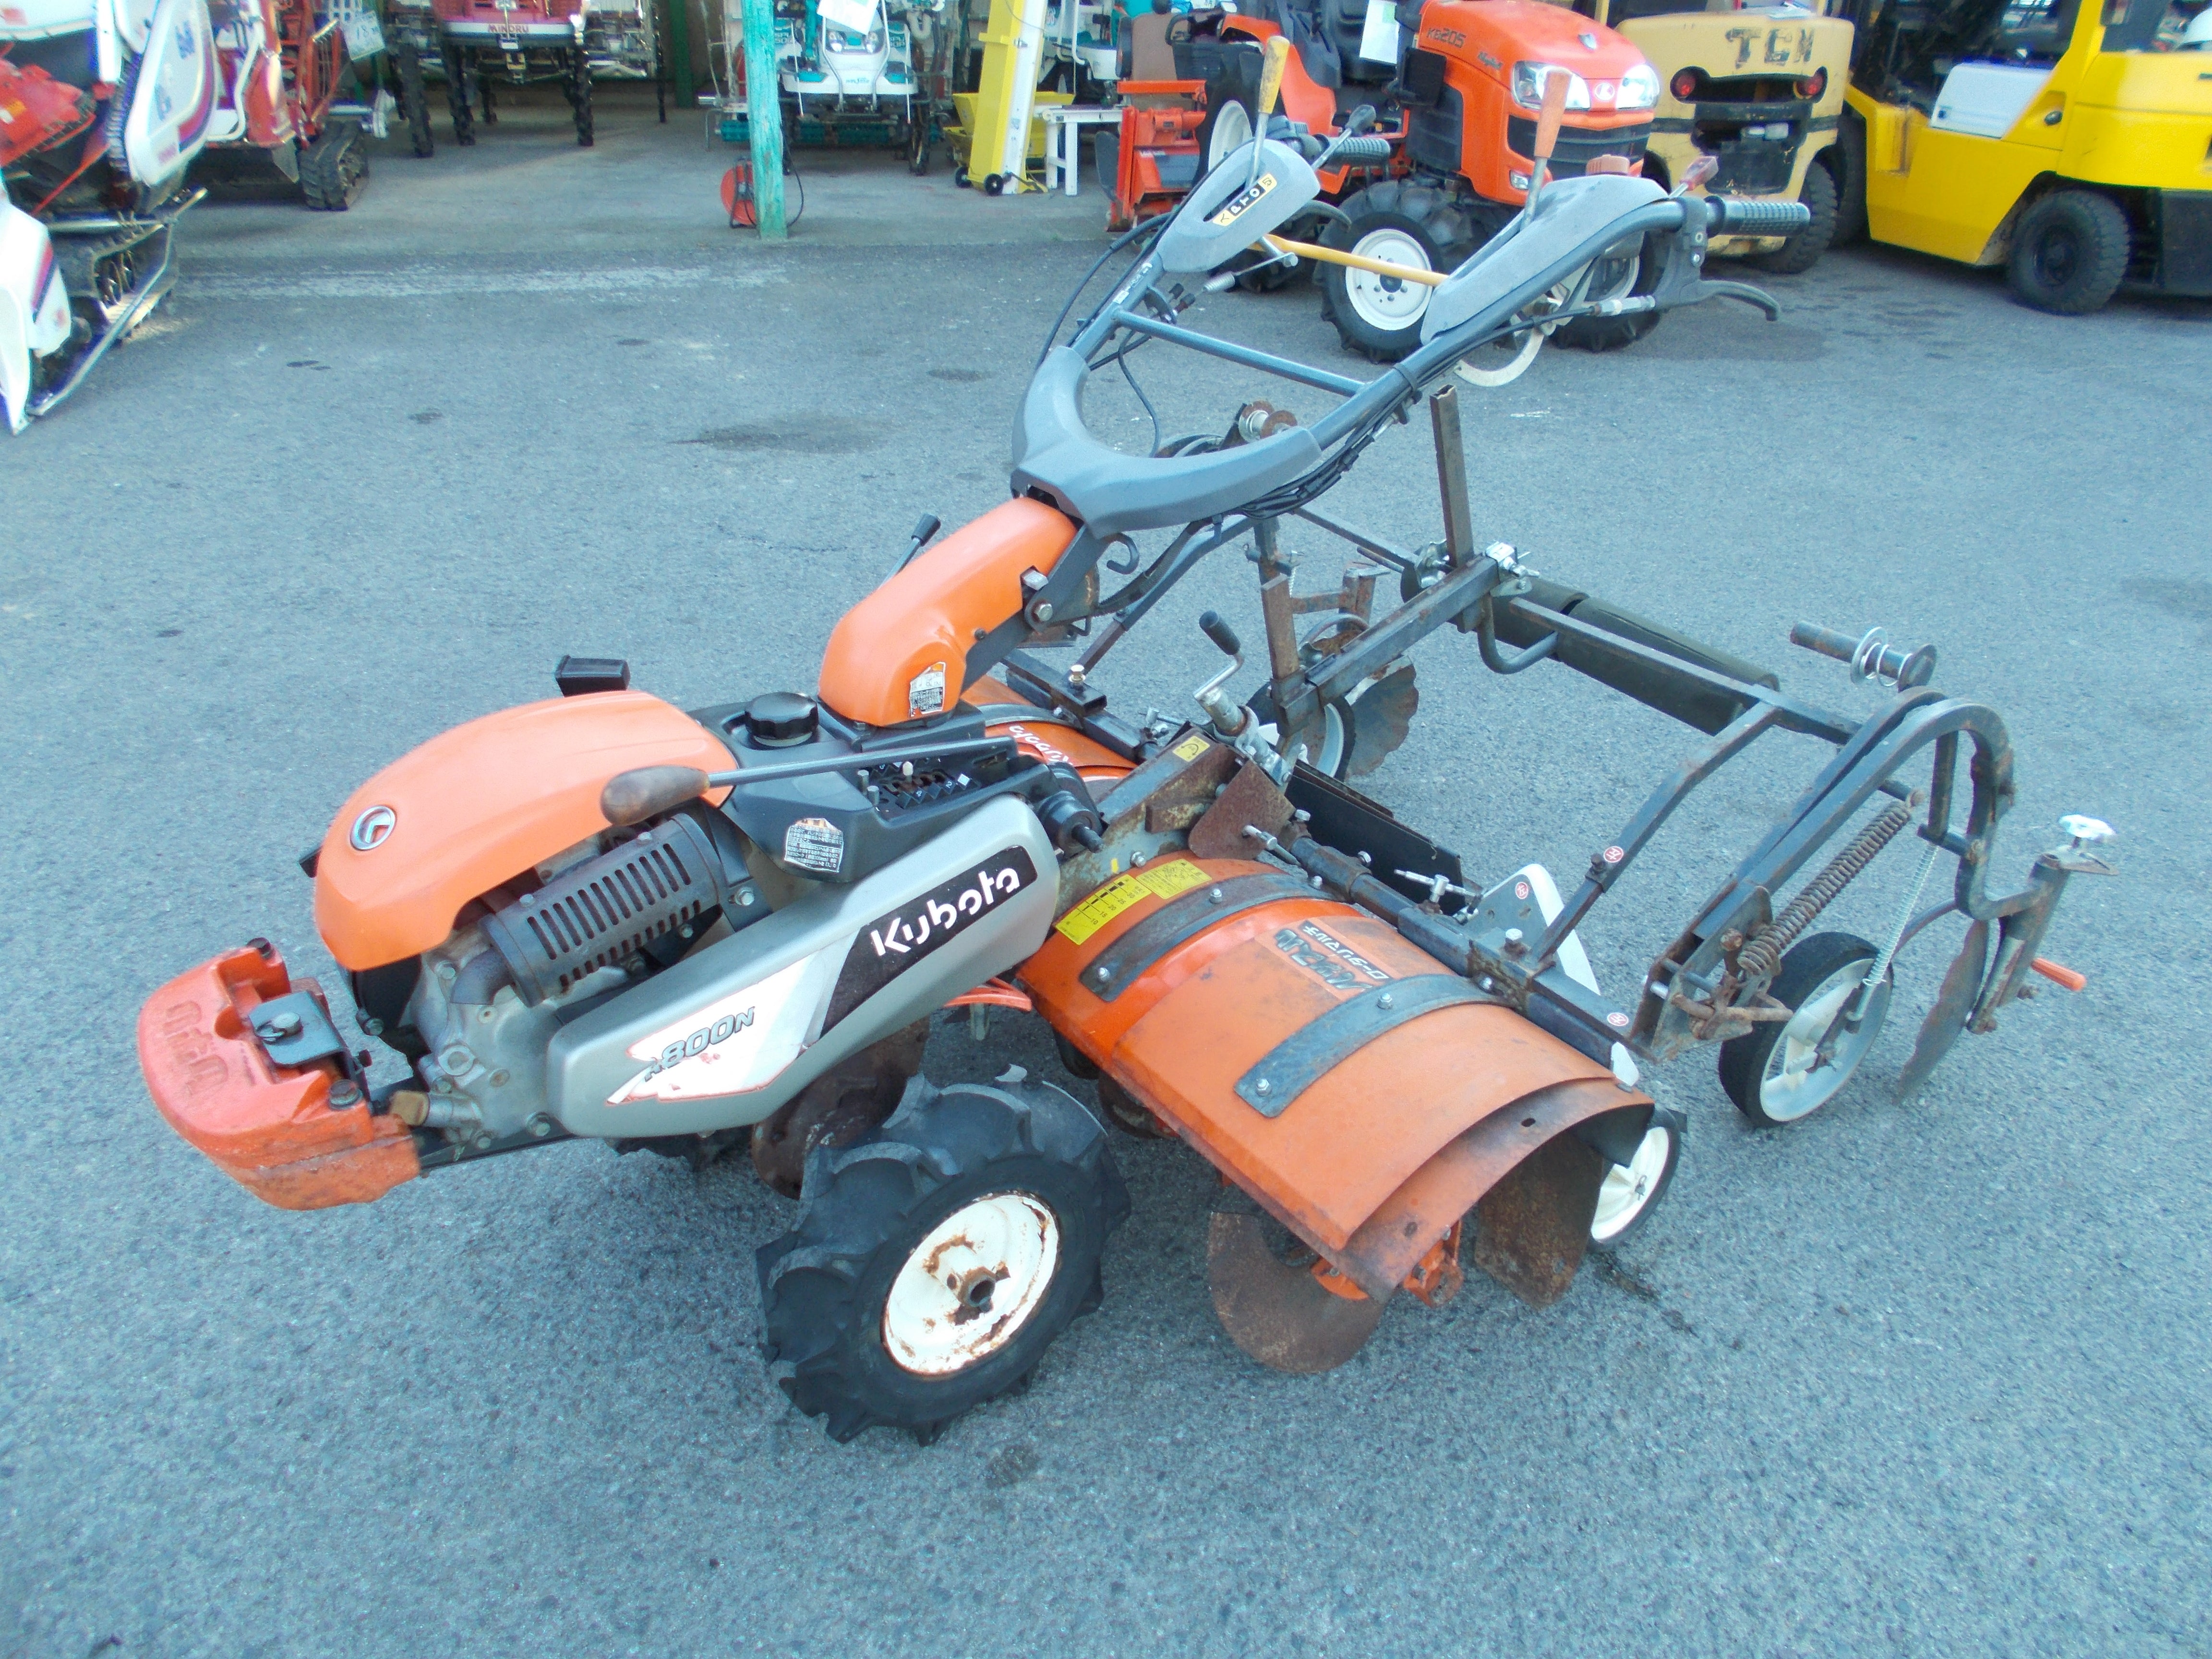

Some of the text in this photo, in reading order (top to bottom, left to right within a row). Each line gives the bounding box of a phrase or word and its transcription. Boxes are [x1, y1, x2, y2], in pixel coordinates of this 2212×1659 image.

[1725, 27, 1814, 70] TCM
[1230, 188, 1261, 214] PTO
[870, 868, 1020, 956] Kubota
